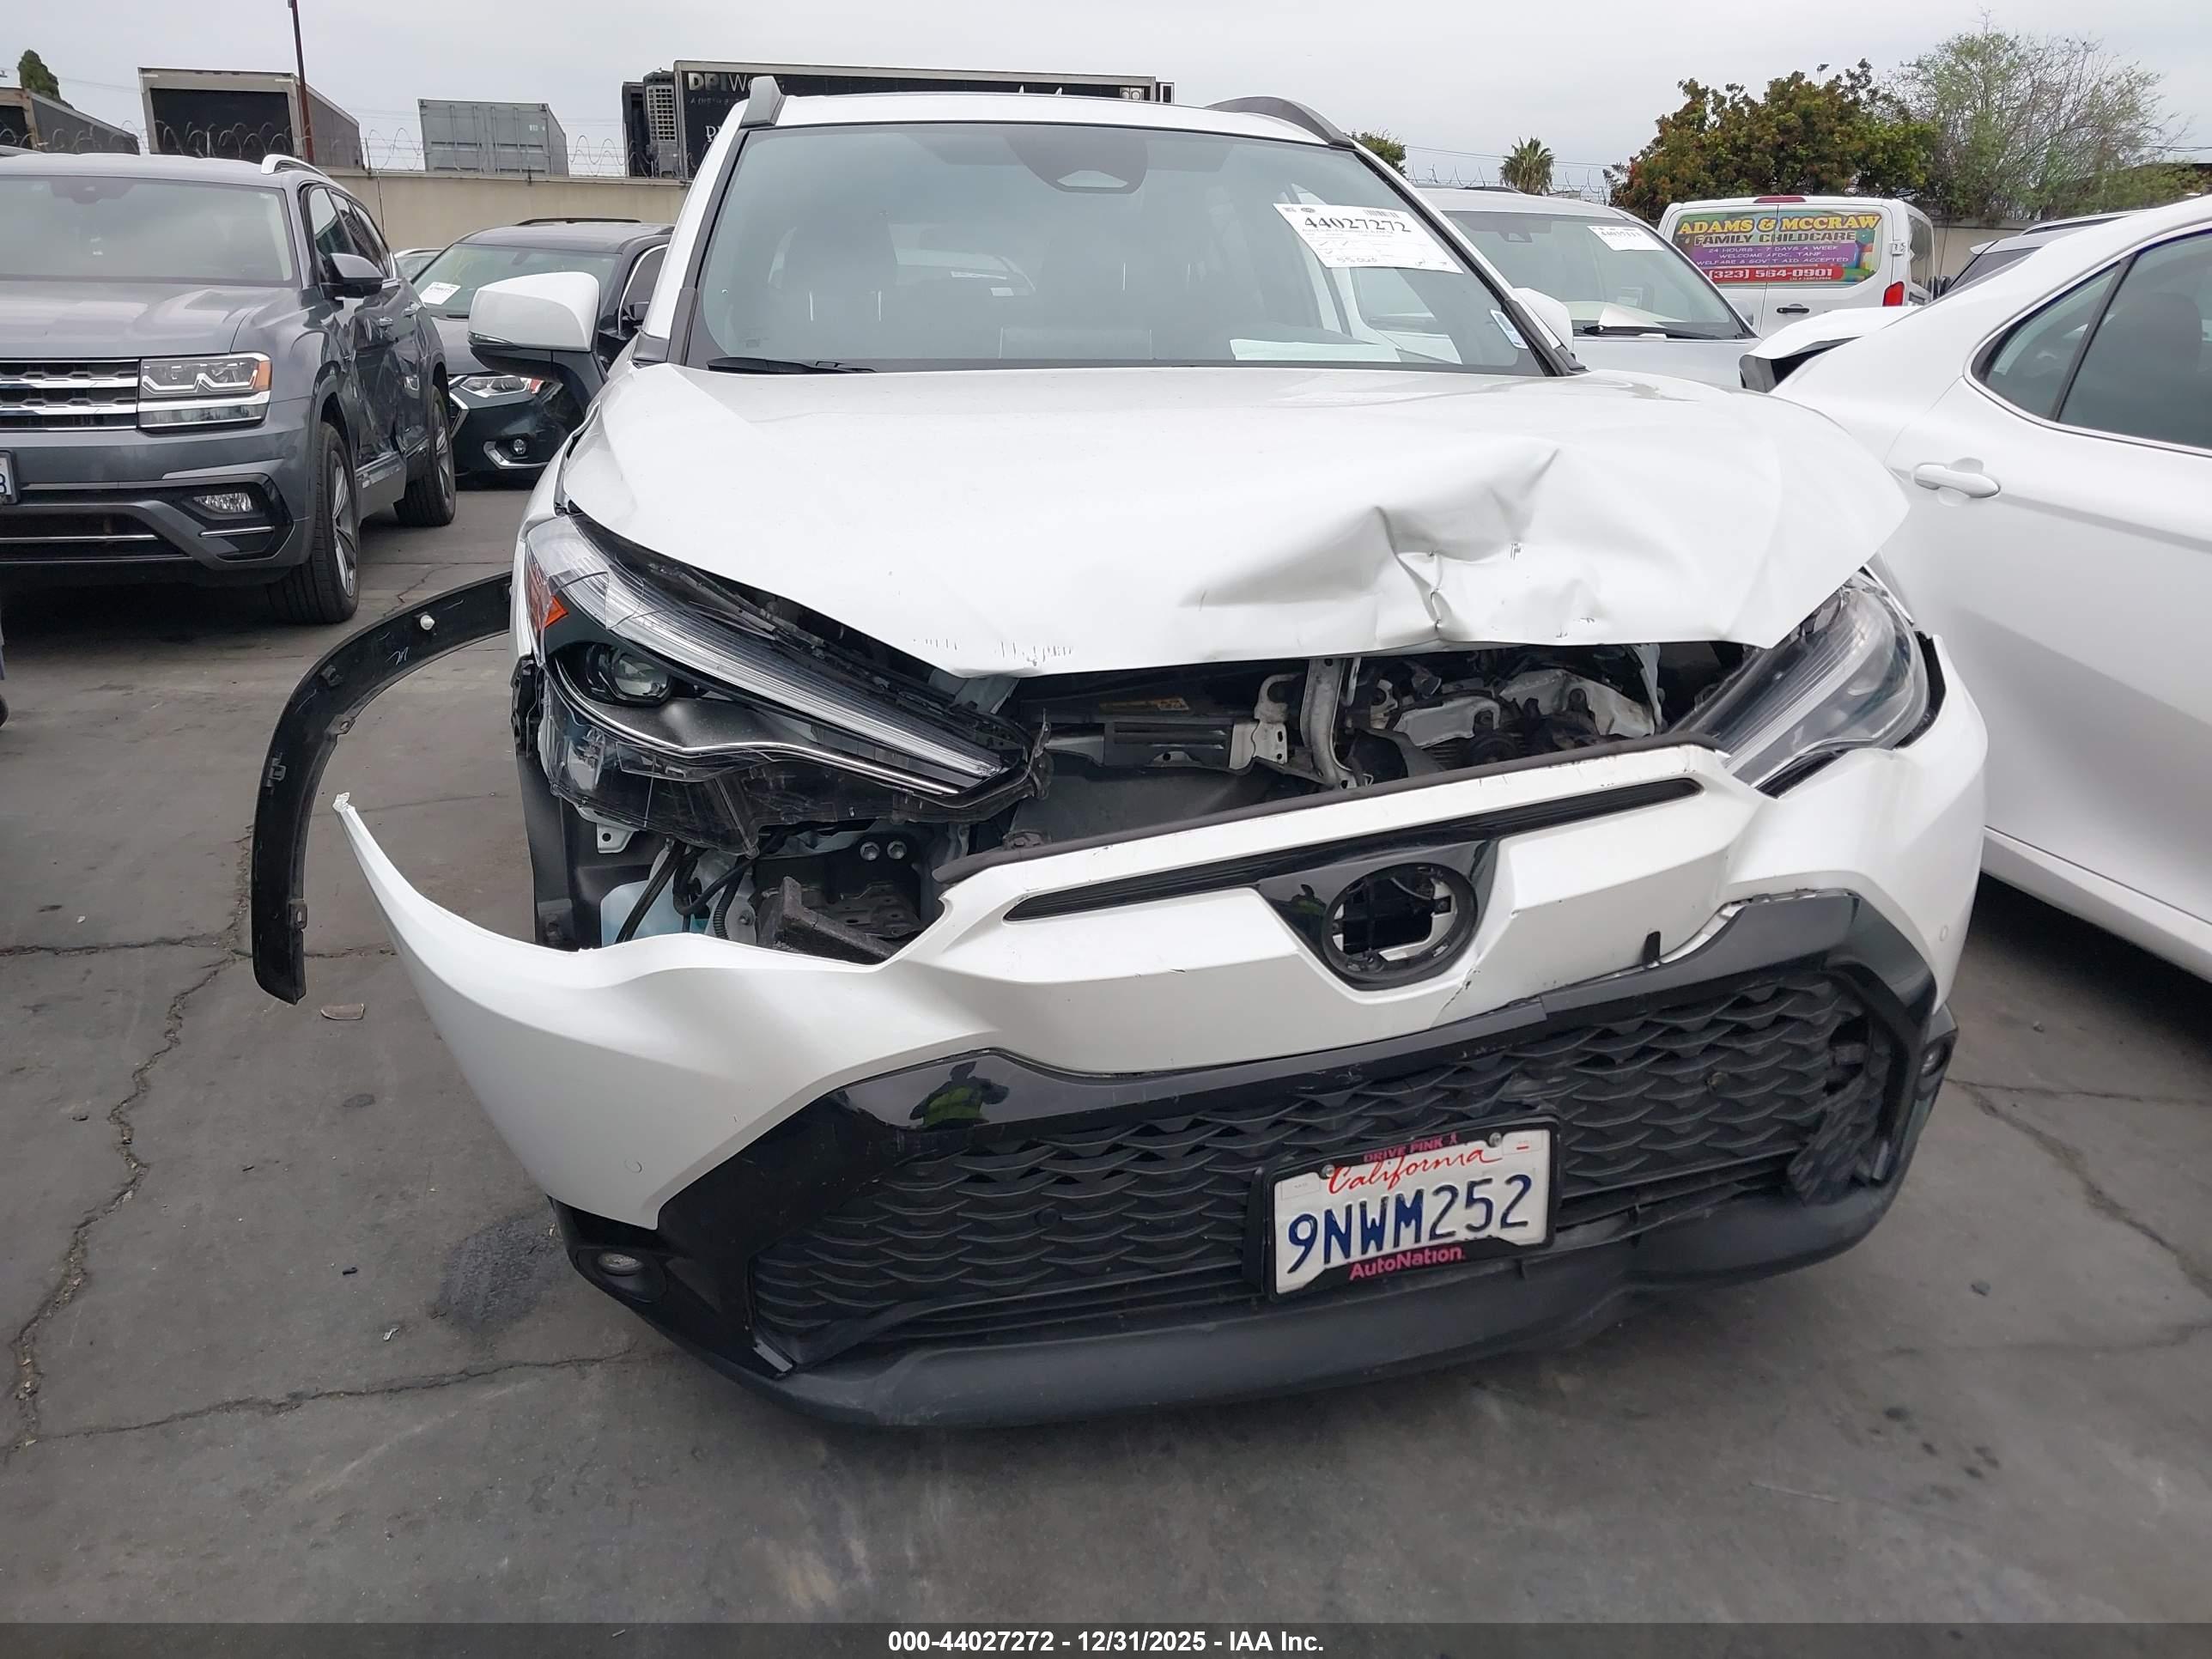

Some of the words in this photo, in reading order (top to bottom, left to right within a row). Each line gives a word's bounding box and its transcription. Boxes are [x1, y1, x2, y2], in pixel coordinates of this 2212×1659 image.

[1304, 217, 1411, 233] 44027272
[1678, 219, 1753, 234] ADAMS
[1759, 217, 1777, 232] &
[1780, 216, 1881, 231] MCCRAW
[1695, 234, 1753, 246] FAMILY
[1759, 232, 1856, 243] CHILDCARE
[1708, 269, 1750, 280] (323)
[1755, 268, 1832, 278] 564-0901
[1363, 1145, 1407, 1164] DRIVE
[1409, 1137, 1443, 1154] PINK
[1328, 1146, 1503, 1194] California
[1287, 1174, 1533, 1274] 9NWM252
[1349, 1245, 1463, 1280] AutoNation
